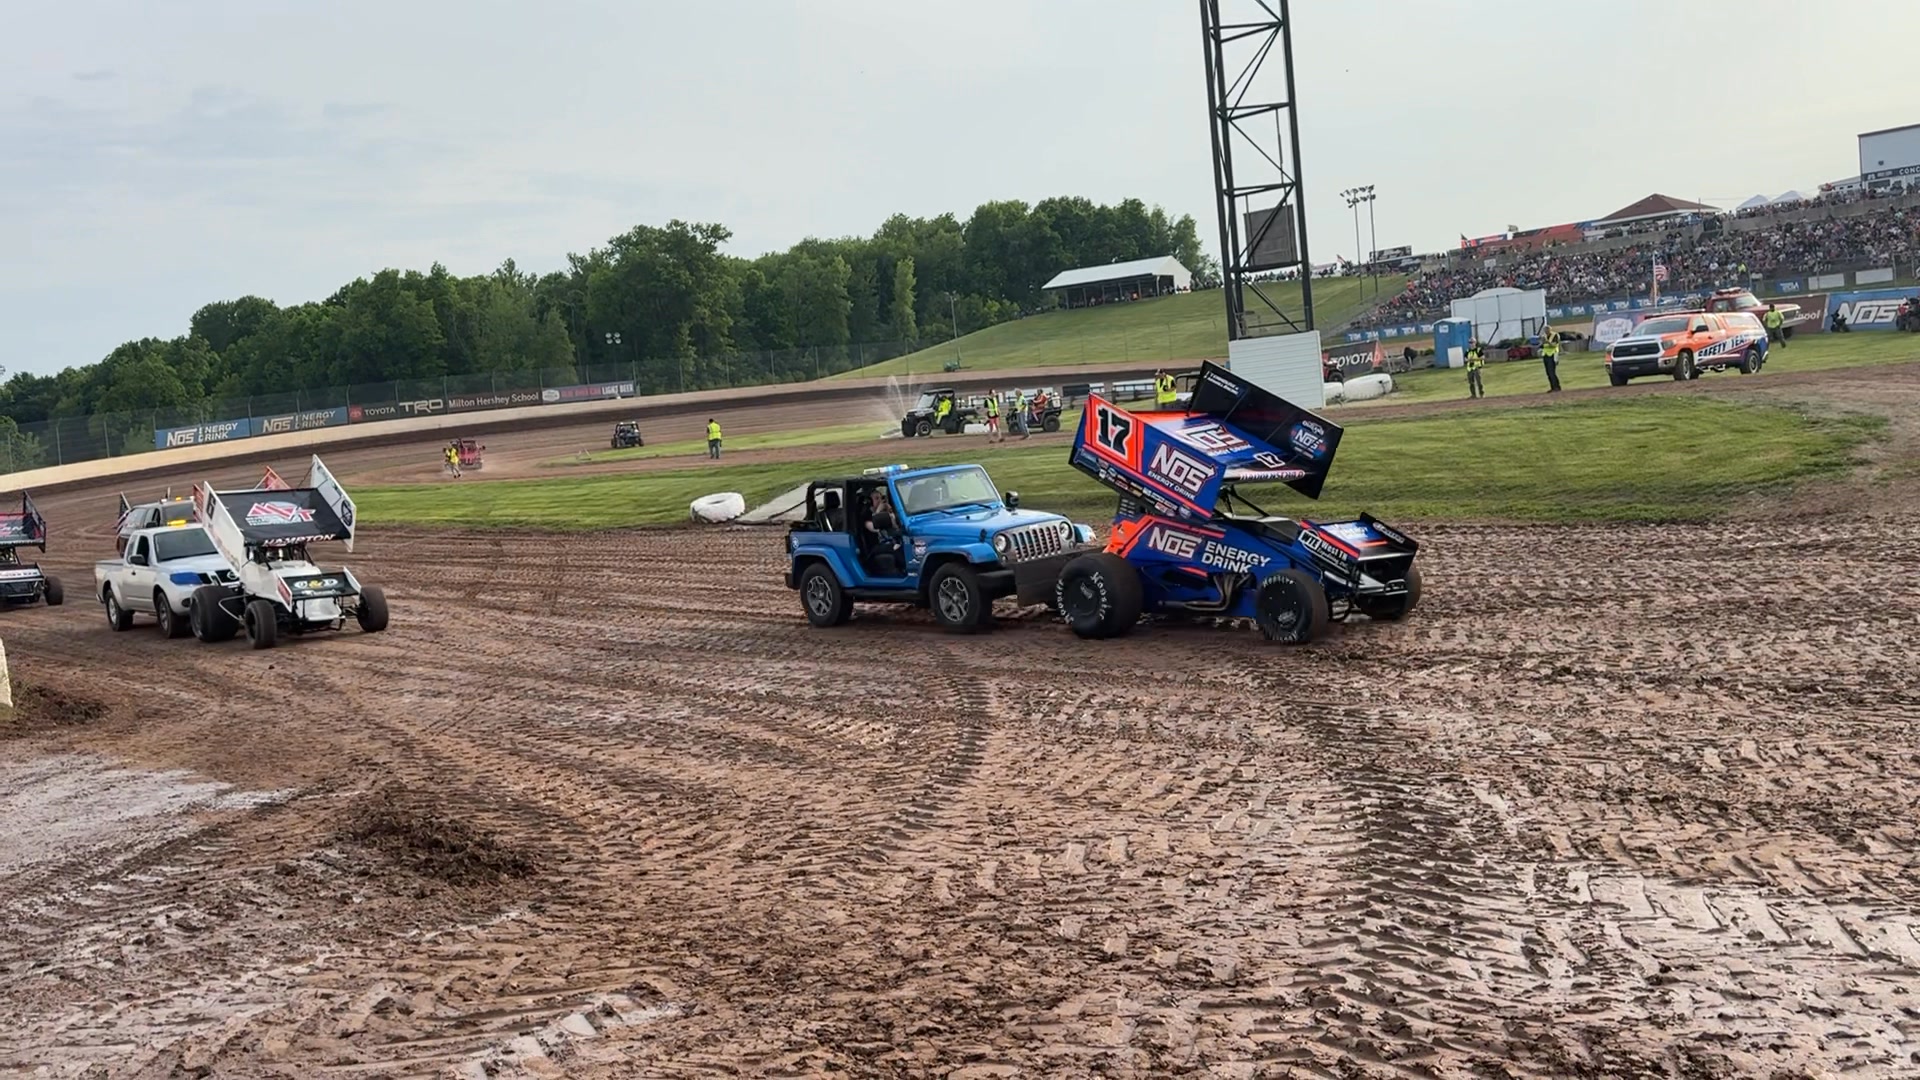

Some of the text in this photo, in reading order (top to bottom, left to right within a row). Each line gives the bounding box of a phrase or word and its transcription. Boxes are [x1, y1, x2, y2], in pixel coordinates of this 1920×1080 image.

[1838, 298, 1906, 325] NOS
[1698, 341, 1727, 357] SAFETY
[364, 399, 444, 416] TOYOTA TRD
[449, 397, 475, 408] Milton
[476, 395, 510, 406] Hershey
[511, 393, 539, 402] School
[262, 415, 294, 433] NOS
[1098, 405, 1132, 460] 17
[166, 428, 198, 447] NOS
[1149, 441, 1216, 494] NOS
[1253, 452, 1286, 469] 17
[1147, 470, 1196, 500] ENERGY DRINK
[262, 533, 336, 547] HAMPTON
[1148, 526, 1202, 560] NOS
[1201, 554, 1252, 573] DRINK
[1204, 540, 1271, 568] ENERGY
